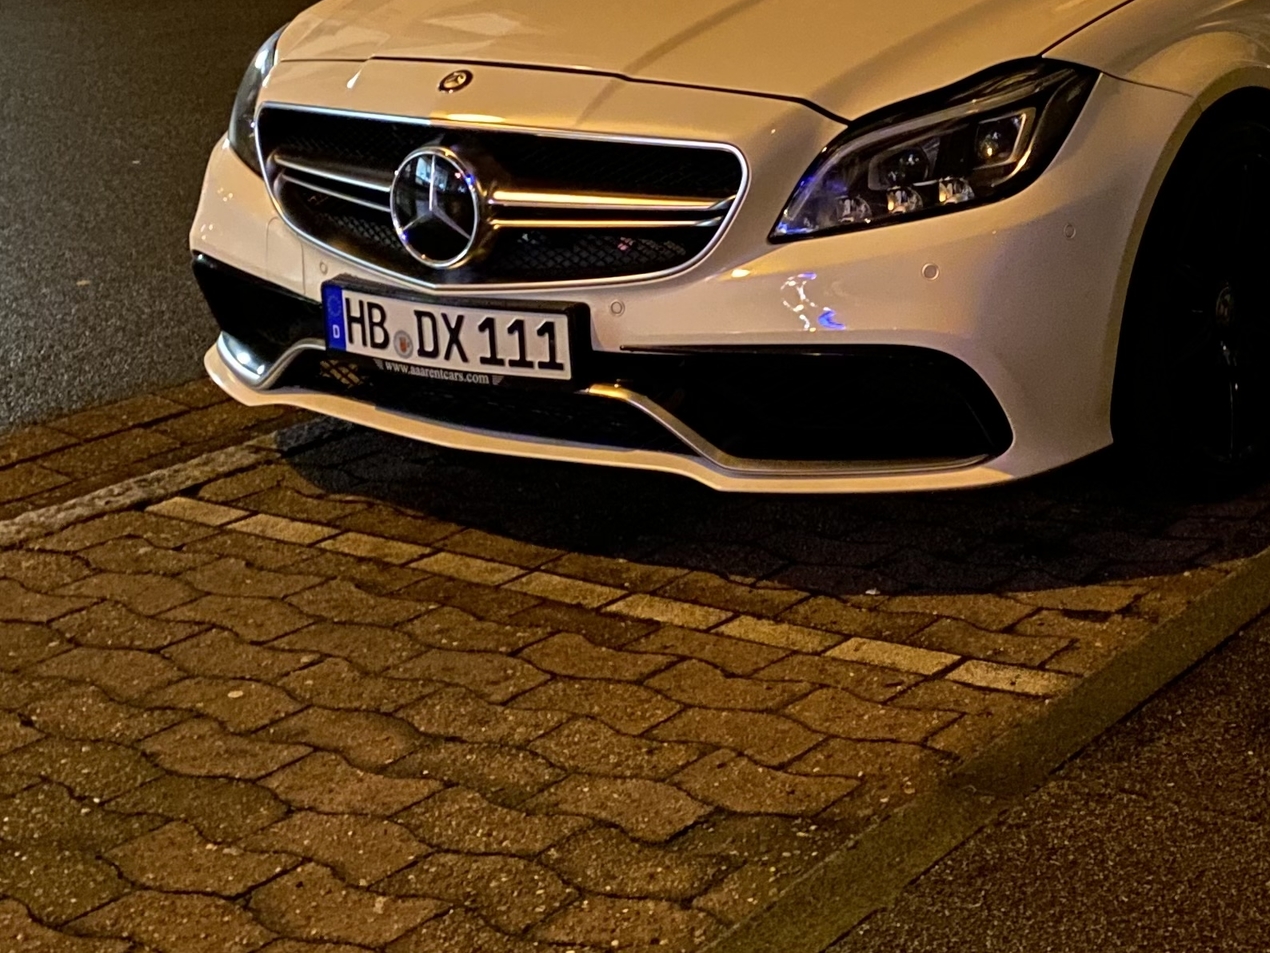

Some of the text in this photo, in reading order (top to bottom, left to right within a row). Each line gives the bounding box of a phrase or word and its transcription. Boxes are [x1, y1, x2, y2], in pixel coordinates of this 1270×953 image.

[345, 297, 565, 371] HB DX 111
[385, 361, 490, 385] www.aaarentcars.com
